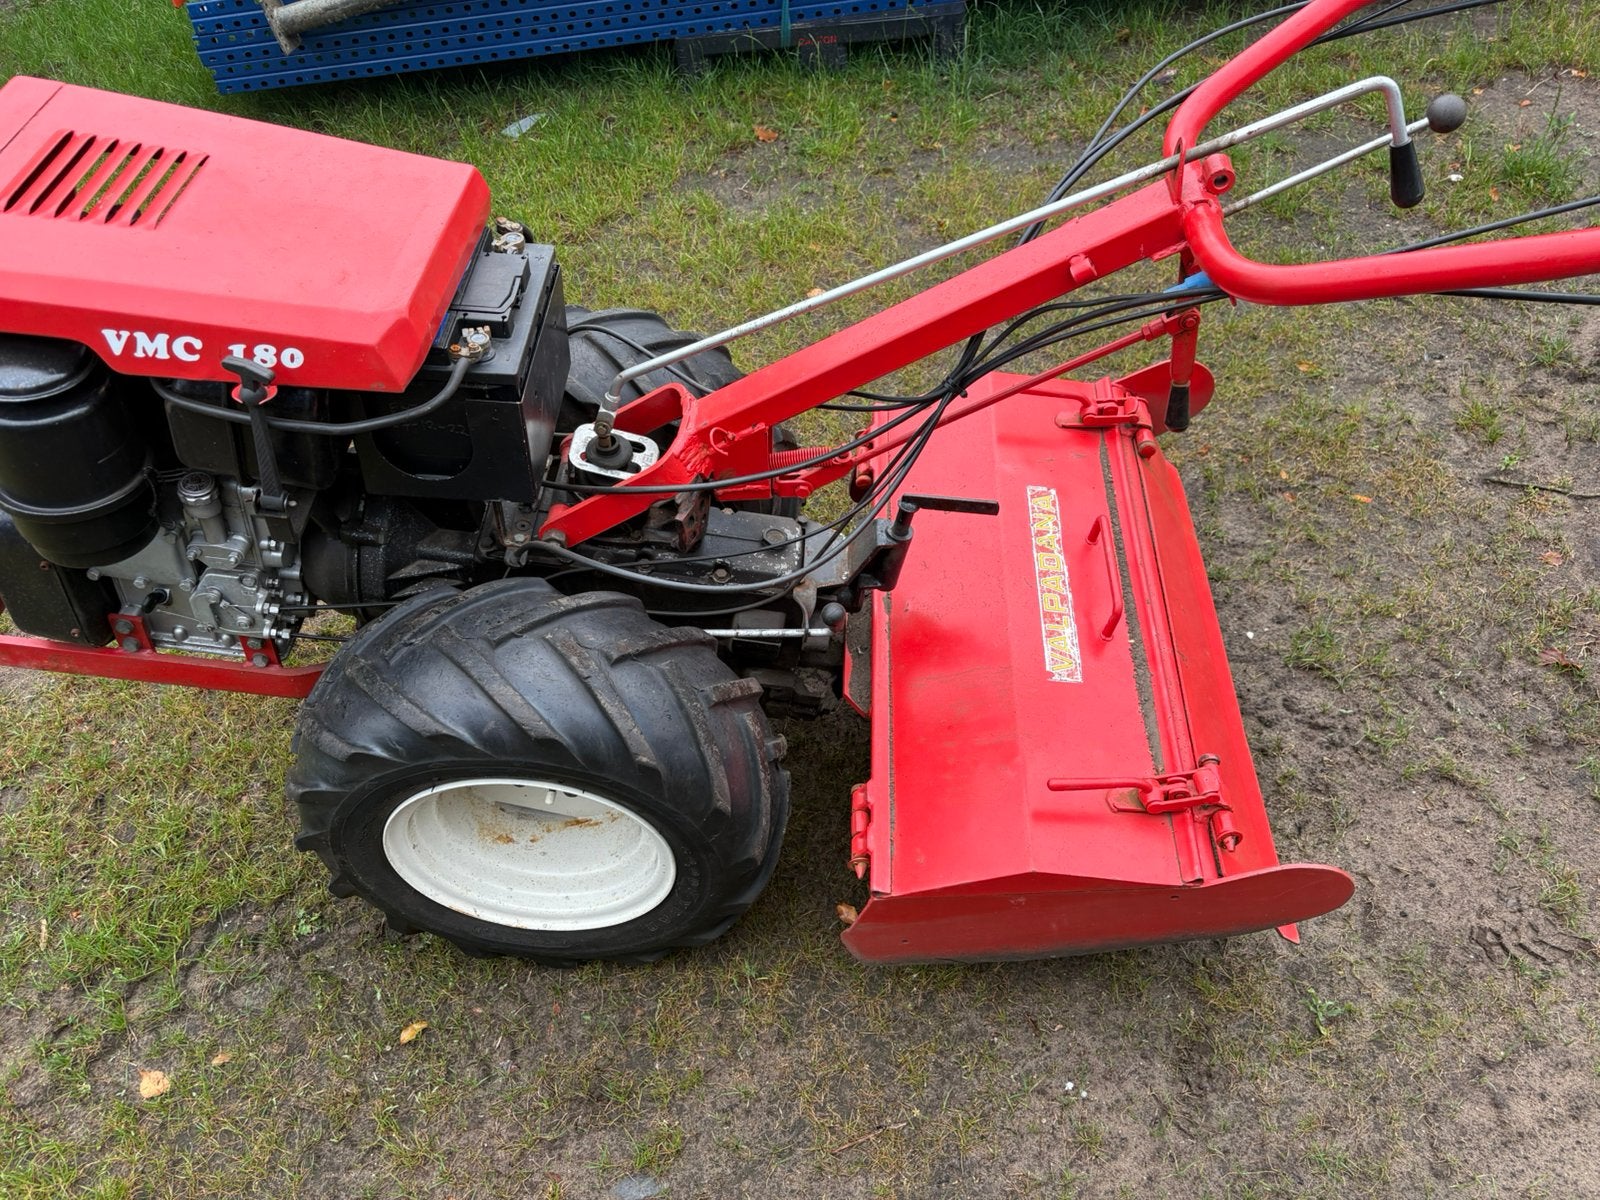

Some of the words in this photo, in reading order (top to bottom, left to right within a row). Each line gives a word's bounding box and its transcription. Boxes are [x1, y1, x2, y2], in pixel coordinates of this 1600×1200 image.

[101, 328, 203, 362] VMC
[227, 343, 305, 369] 180
[1030, 492, 1075, 673] VALPADANA
